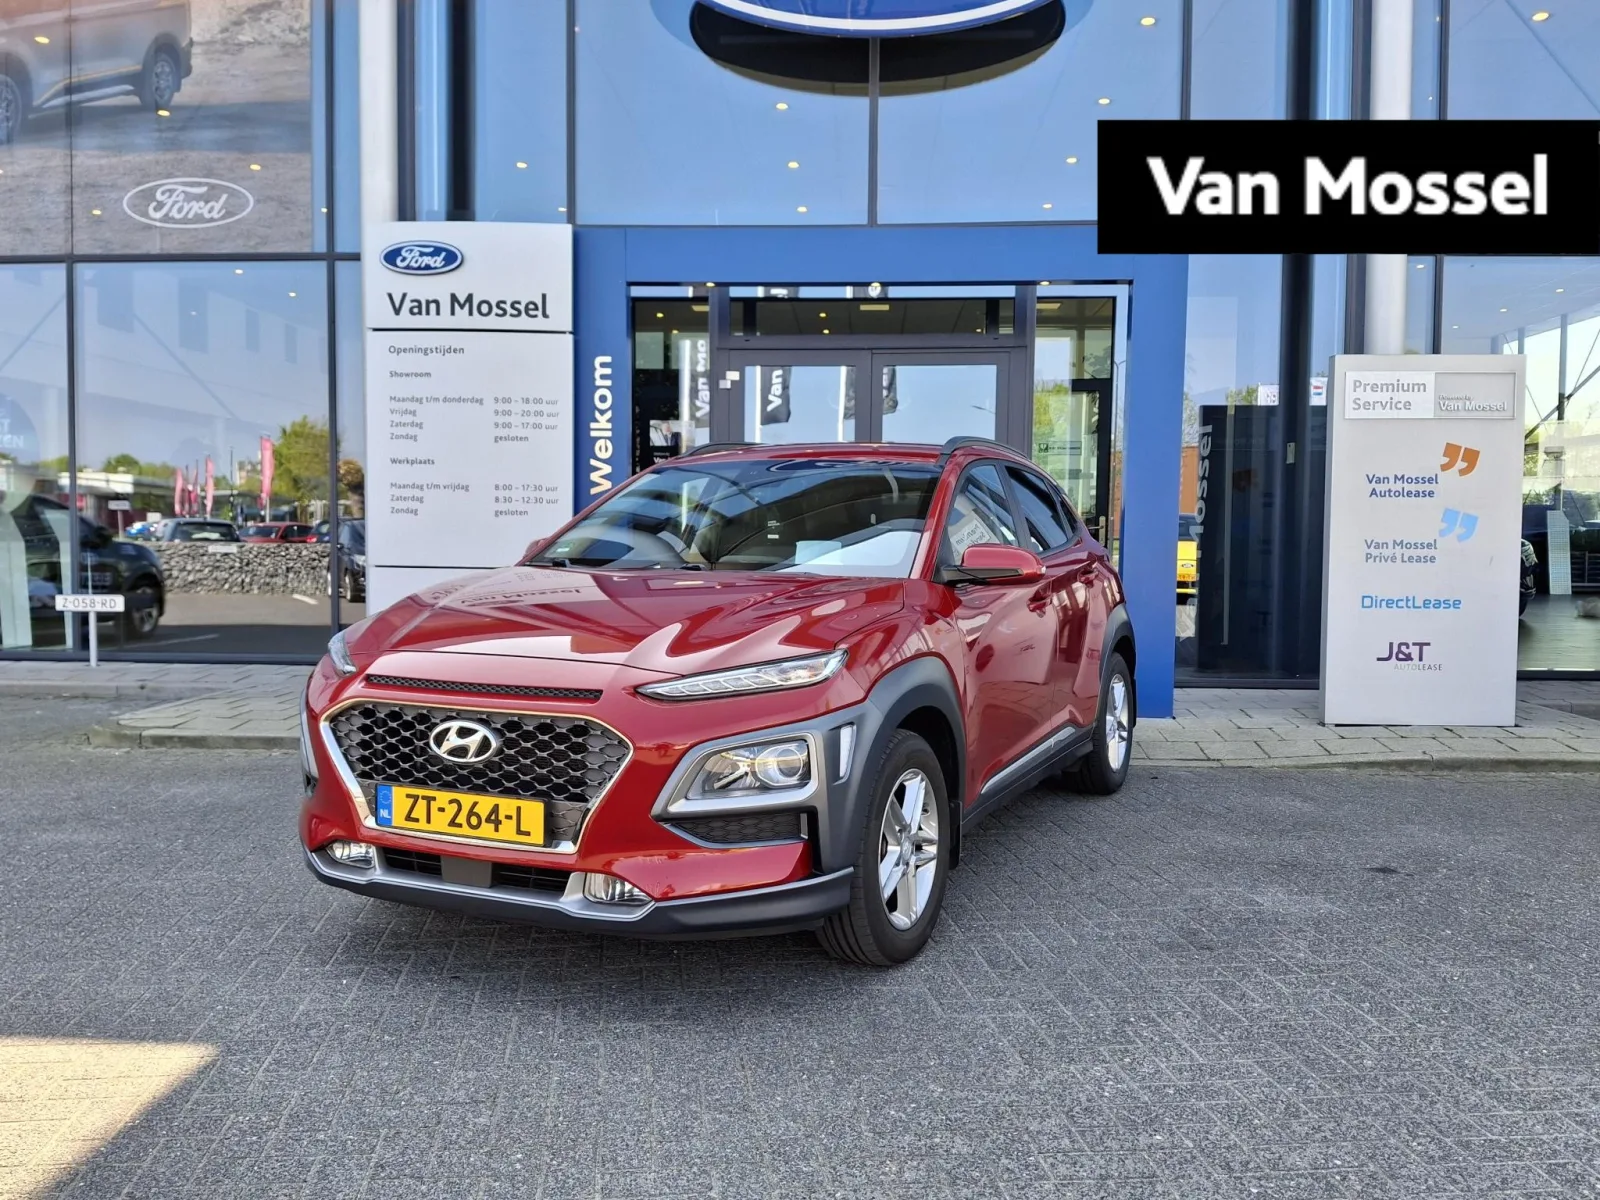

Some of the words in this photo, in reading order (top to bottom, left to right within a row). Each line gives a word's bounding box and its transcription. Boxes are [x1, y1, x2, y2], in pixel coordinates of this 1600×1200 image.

[148, 184, 228, 219] Ford
[396, 246, 446, 268] Ford
[387, 293, 441, 316] Van
[450, 293, 549, 318] Mossel
[388, 345, 465, 356] Openingstijden
[389, 370, 432, 378] Showroom
[766, 369, 783, 412] Van
[1353, 379, 1427, 393] Premium
[389, 395, 424, 404] Maandag
[442, 396, 484, 405] donderdag
[1352, 398, 1412, 411] Service
[1439, 401, 1461, 411] Van
[1465, 401, 1508, 411] Mossel
[390, 408, 417, 417] Vrijdag
[494, 409, 512, 417] 9:00
[390, 420, 423, 429] Zaterdag
[589, 356, 613, 495] Welkom
[390, 433, 418, 442] Zondag
[494, 435, 529, 443] gesloten
[390, 458, 435, 466] Werkplaats
[1366, 474, 1390, 485] Van
[1394, 474, 1439, 485] Mossel
[390, 482, 424, 491] Maandag
[443, 483, 470, 492] vrijdag
[521, 484, 543, 492] 17:30
[1369, 487, 1435, 498] Autolease
[390, 494, 424, 504] Zaterdag
[521, 496, 544, 504] 12:30
[390, 507, 418, 516] Zondag
[494, 509, 529, 517] gesloten
[1365, 539, 1389, 549] Van
[1393, 539, 1438, 549] Mossel
[1365, 553, 1397, 563] Privé
[1401, 553, 1437, 563] Lease
[62, 598, 116, 609] Z-058-RD
[1361, 595, 1462, 609] DirectLease
[1376, 641, 1431, 662] J&T
[1394, 663, 1443, 671] AUTOLEASE
[380, 808, 391, 818] NL
[404, 793, 531, 837] ZT-264-L
